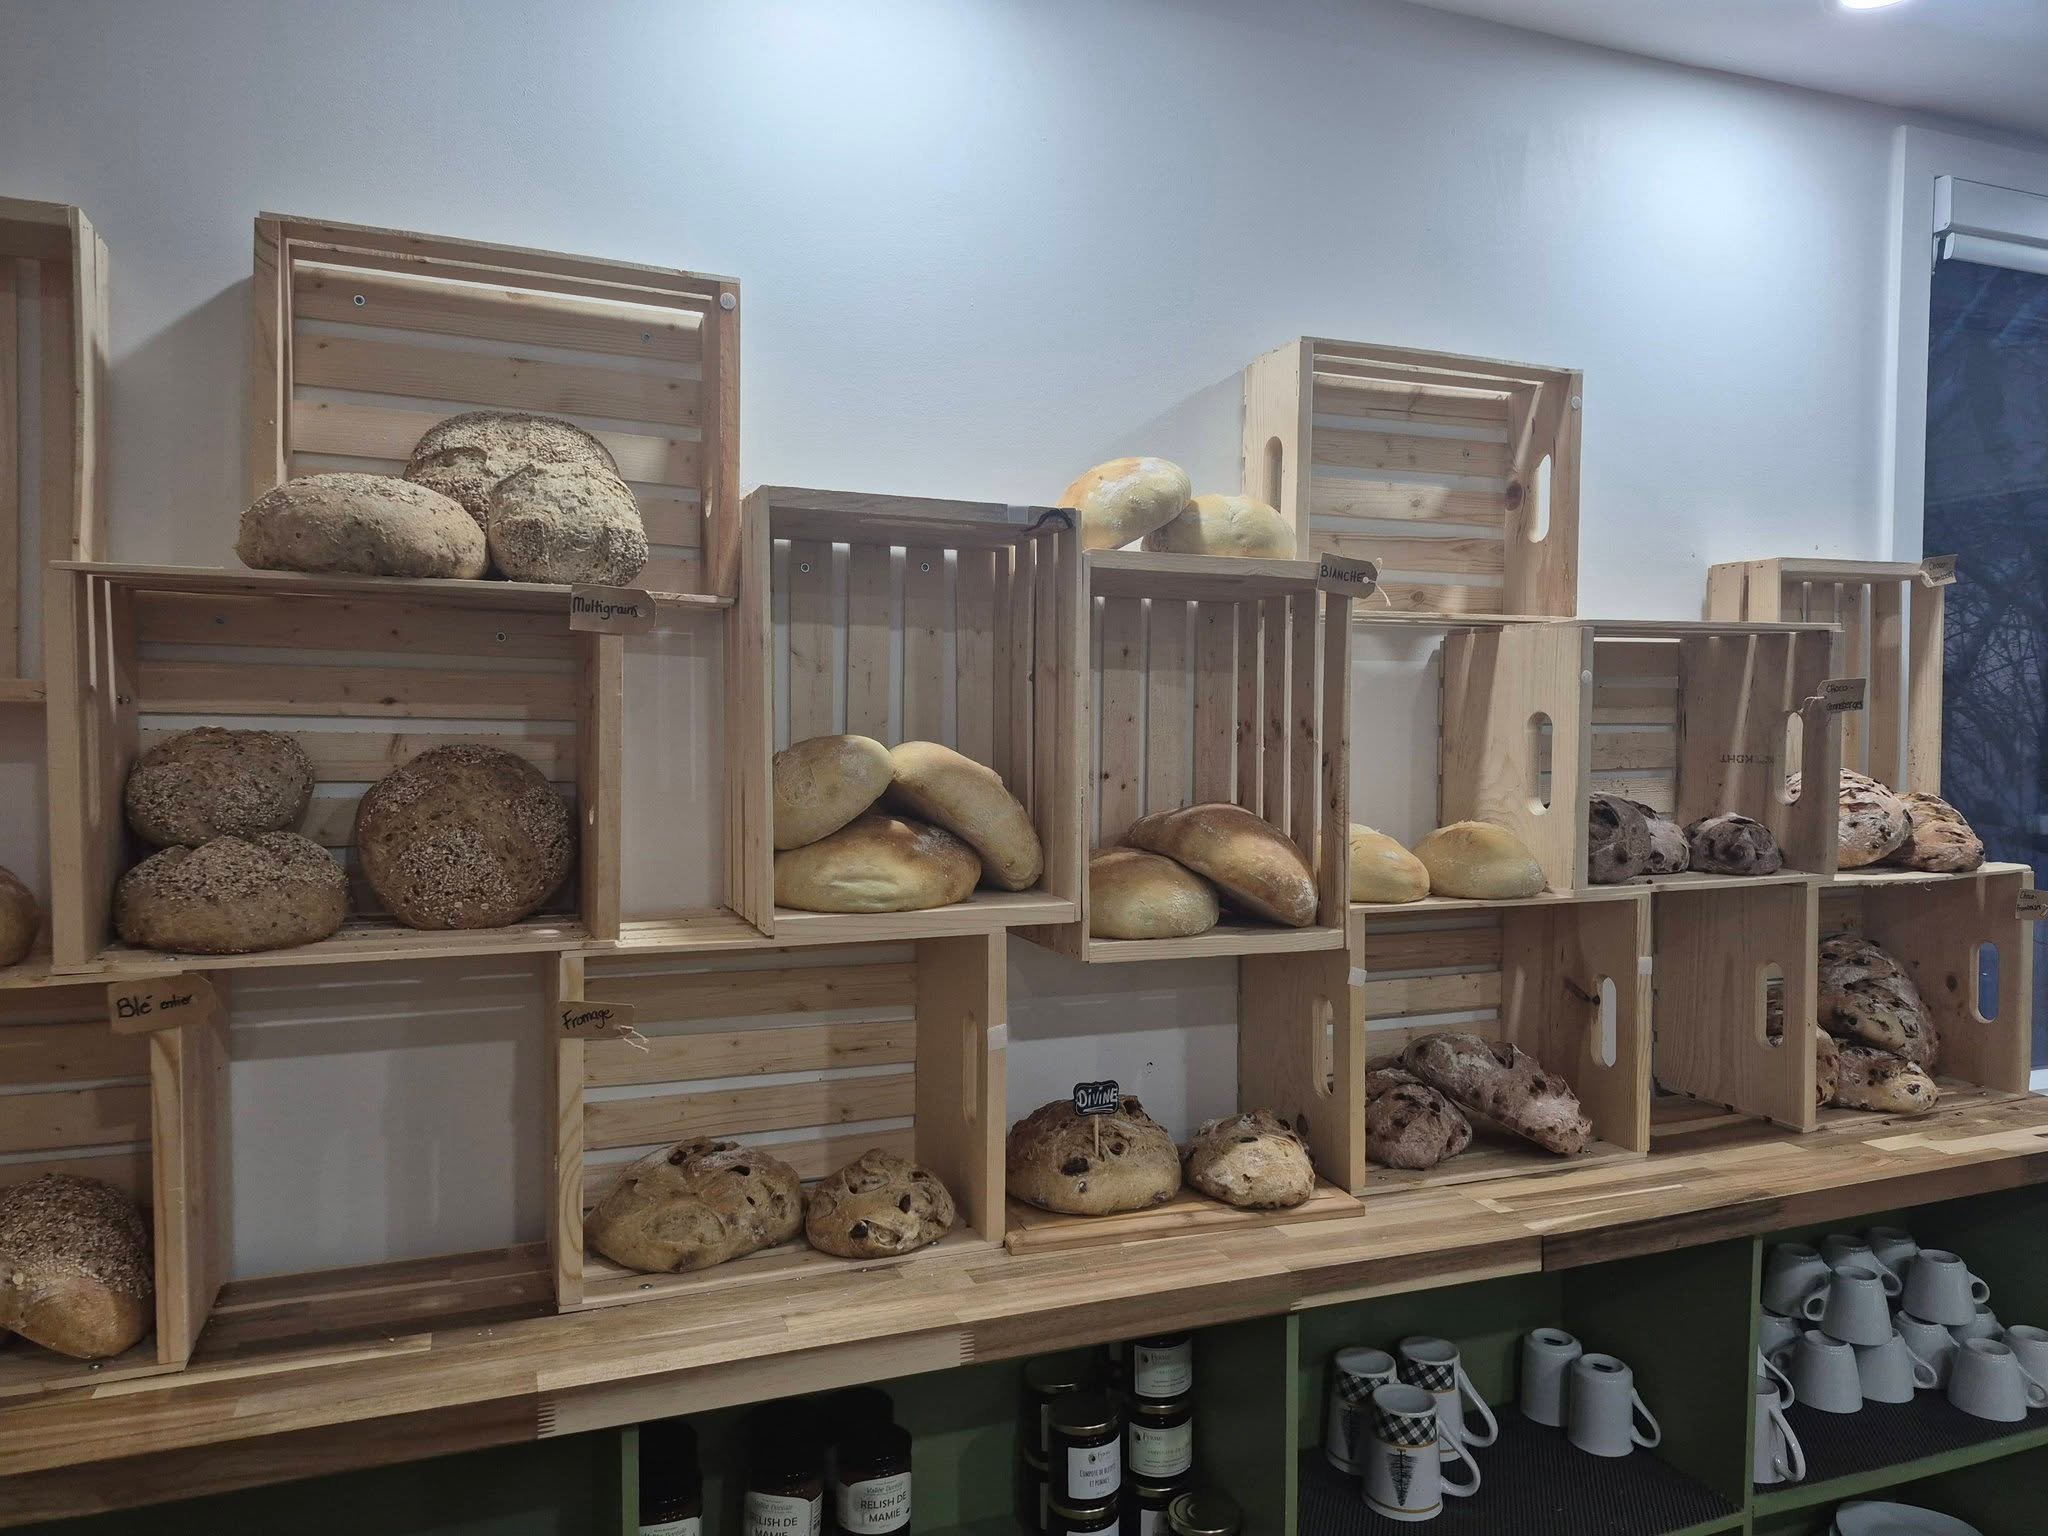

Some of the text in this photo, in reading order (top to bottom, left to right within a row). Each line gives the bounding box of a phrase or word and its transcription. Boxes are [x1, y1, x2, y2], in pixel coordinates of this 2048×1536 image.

[572, 596, 638, 620] Multigrains
[116, 994, 153, 1018] Blé
[561, 1008, 615, 1031] Fromage
[860, 1490, 907, 1510] RELISH DE
[783, 1516, 798, 1527] DE
[868, 1507, 901, 1523] MAMIE
